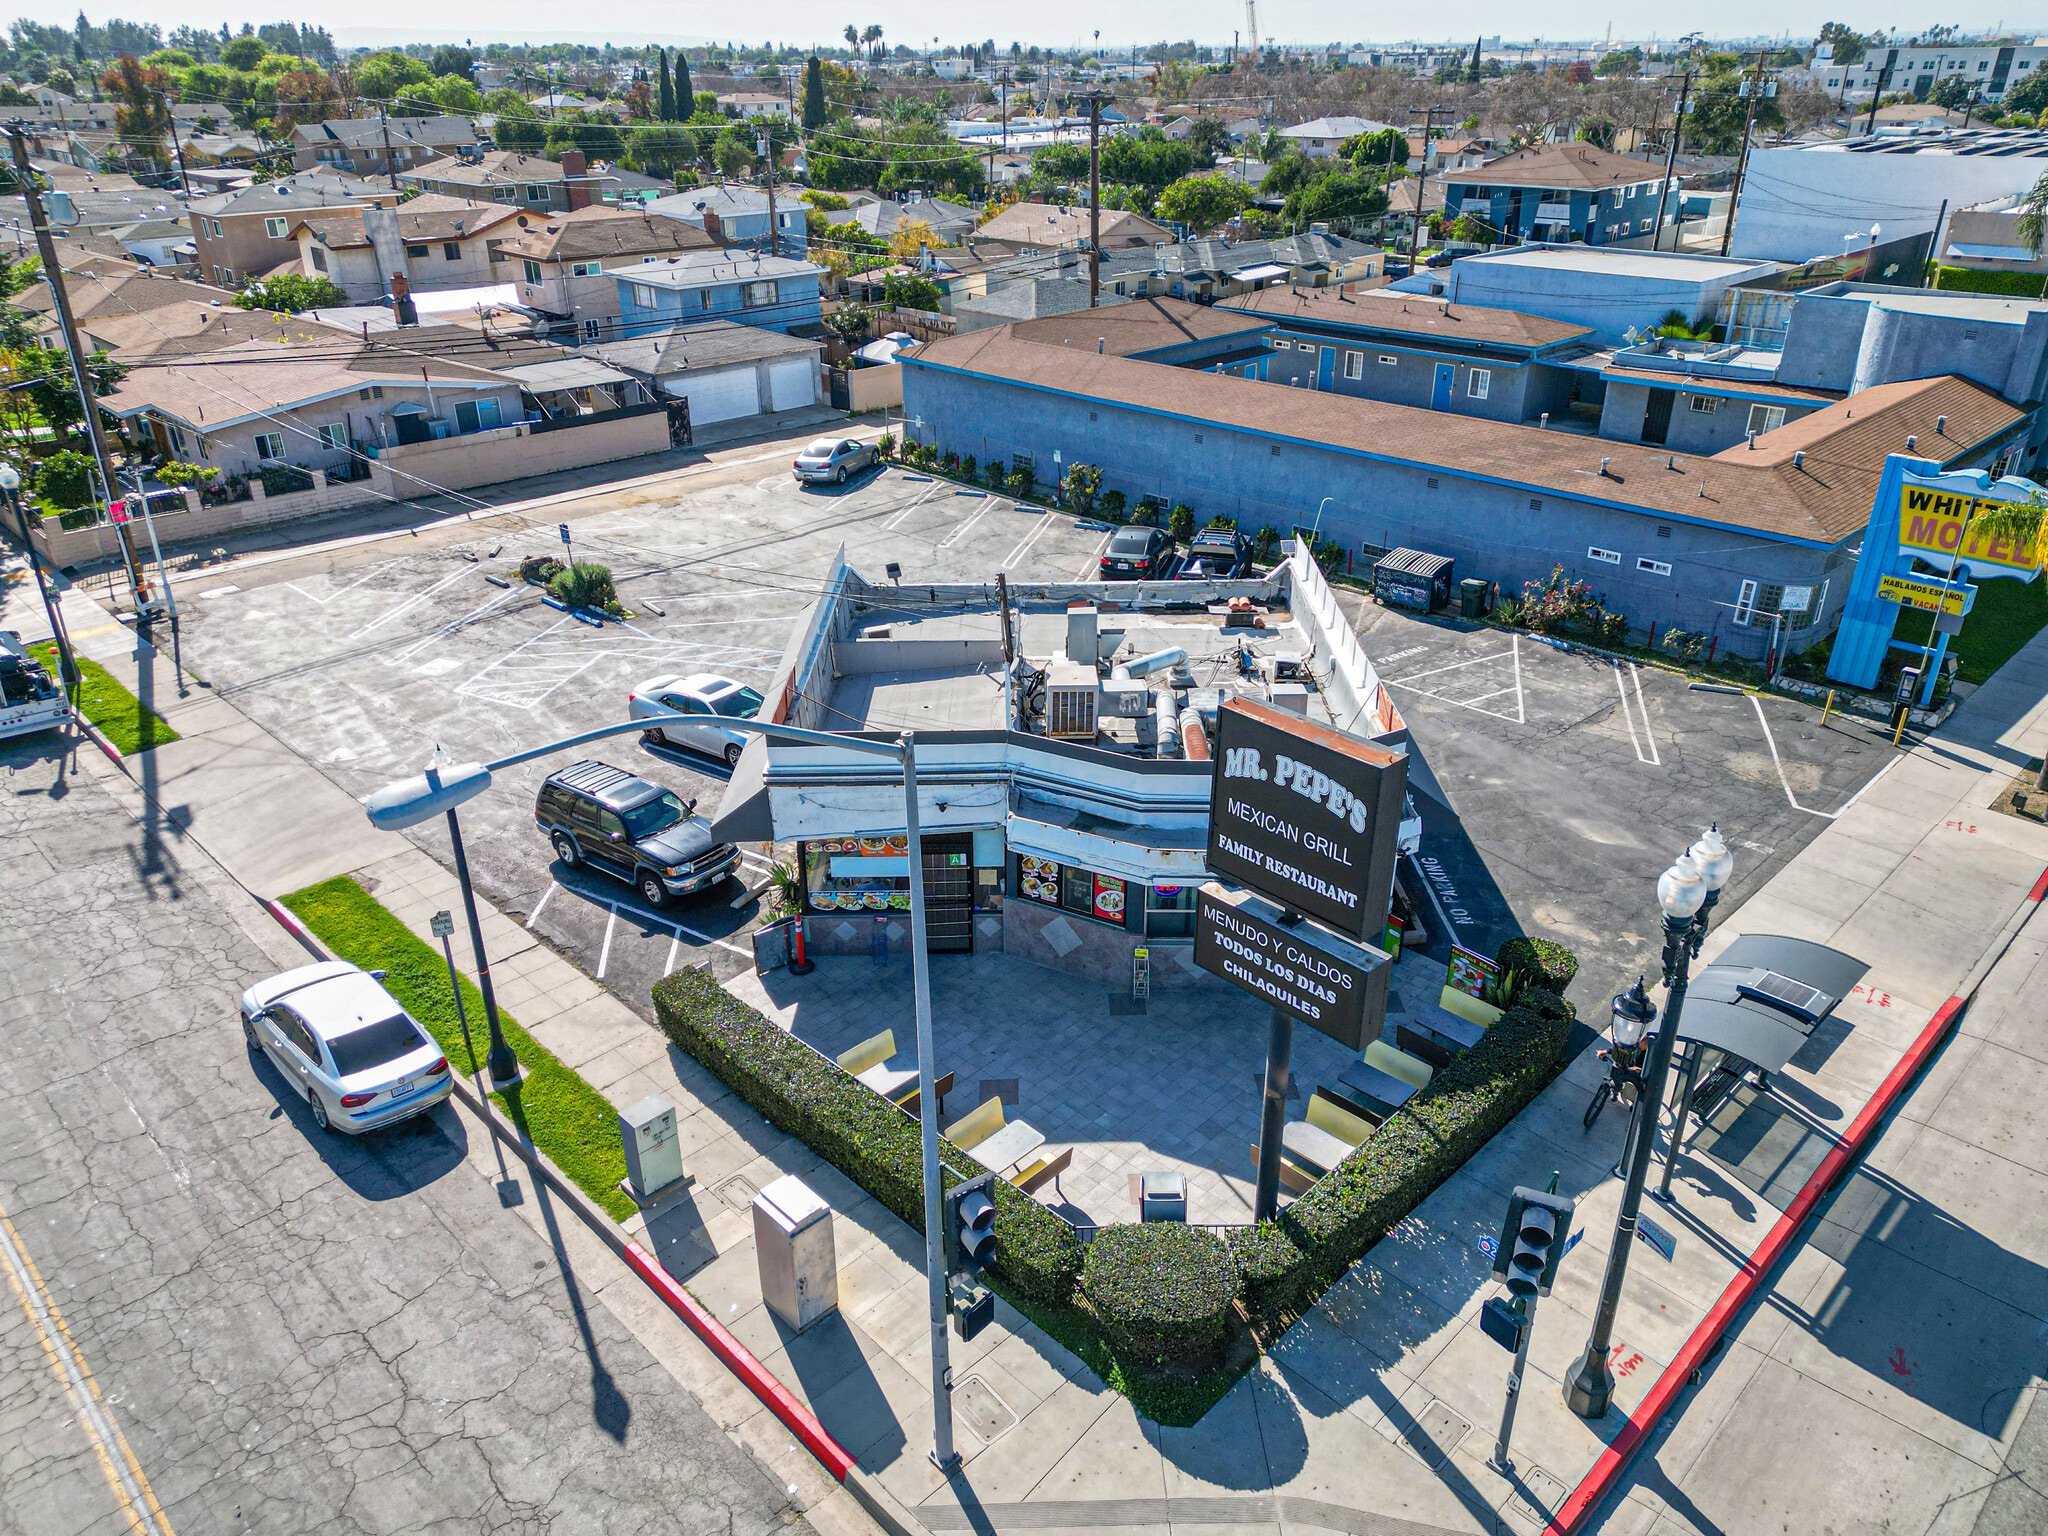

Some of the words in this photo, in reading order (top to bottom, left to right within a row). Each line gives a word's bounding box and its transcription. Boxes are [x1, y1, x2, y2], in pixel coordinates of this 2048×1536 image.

[1883, 578, 1927, 594] HABLAMOS
[1377, 645, 1429, 664] PARKING
[1224, 747, 1268, 781] MR.
[1273, 754, 1367, 834] PEPE'S
[1227, 797, 1299, 843] MEXICAN
[1303, 831, 1352, 867] GRILL
[1218, 833, 1264, 866] FAMILY
[1265, 855, 1358, 909] RESTAURANT
[1421, 857, 1459, 903] PARKING
[1204, 904, 1268, 947] MENUDO
[1272, 938, 1283, 954] Y
[1286, 946, 1353, 990] CALDOS
[1449, 908, 1474, 924] NO
[1214, 931, 1263, 966] TODOS
[1265, 957, 1294, 983] LOS
[1297, 973, 1337, 1005] DIAS
[1223, 959, 1321, 1020] CHILAQUILES
